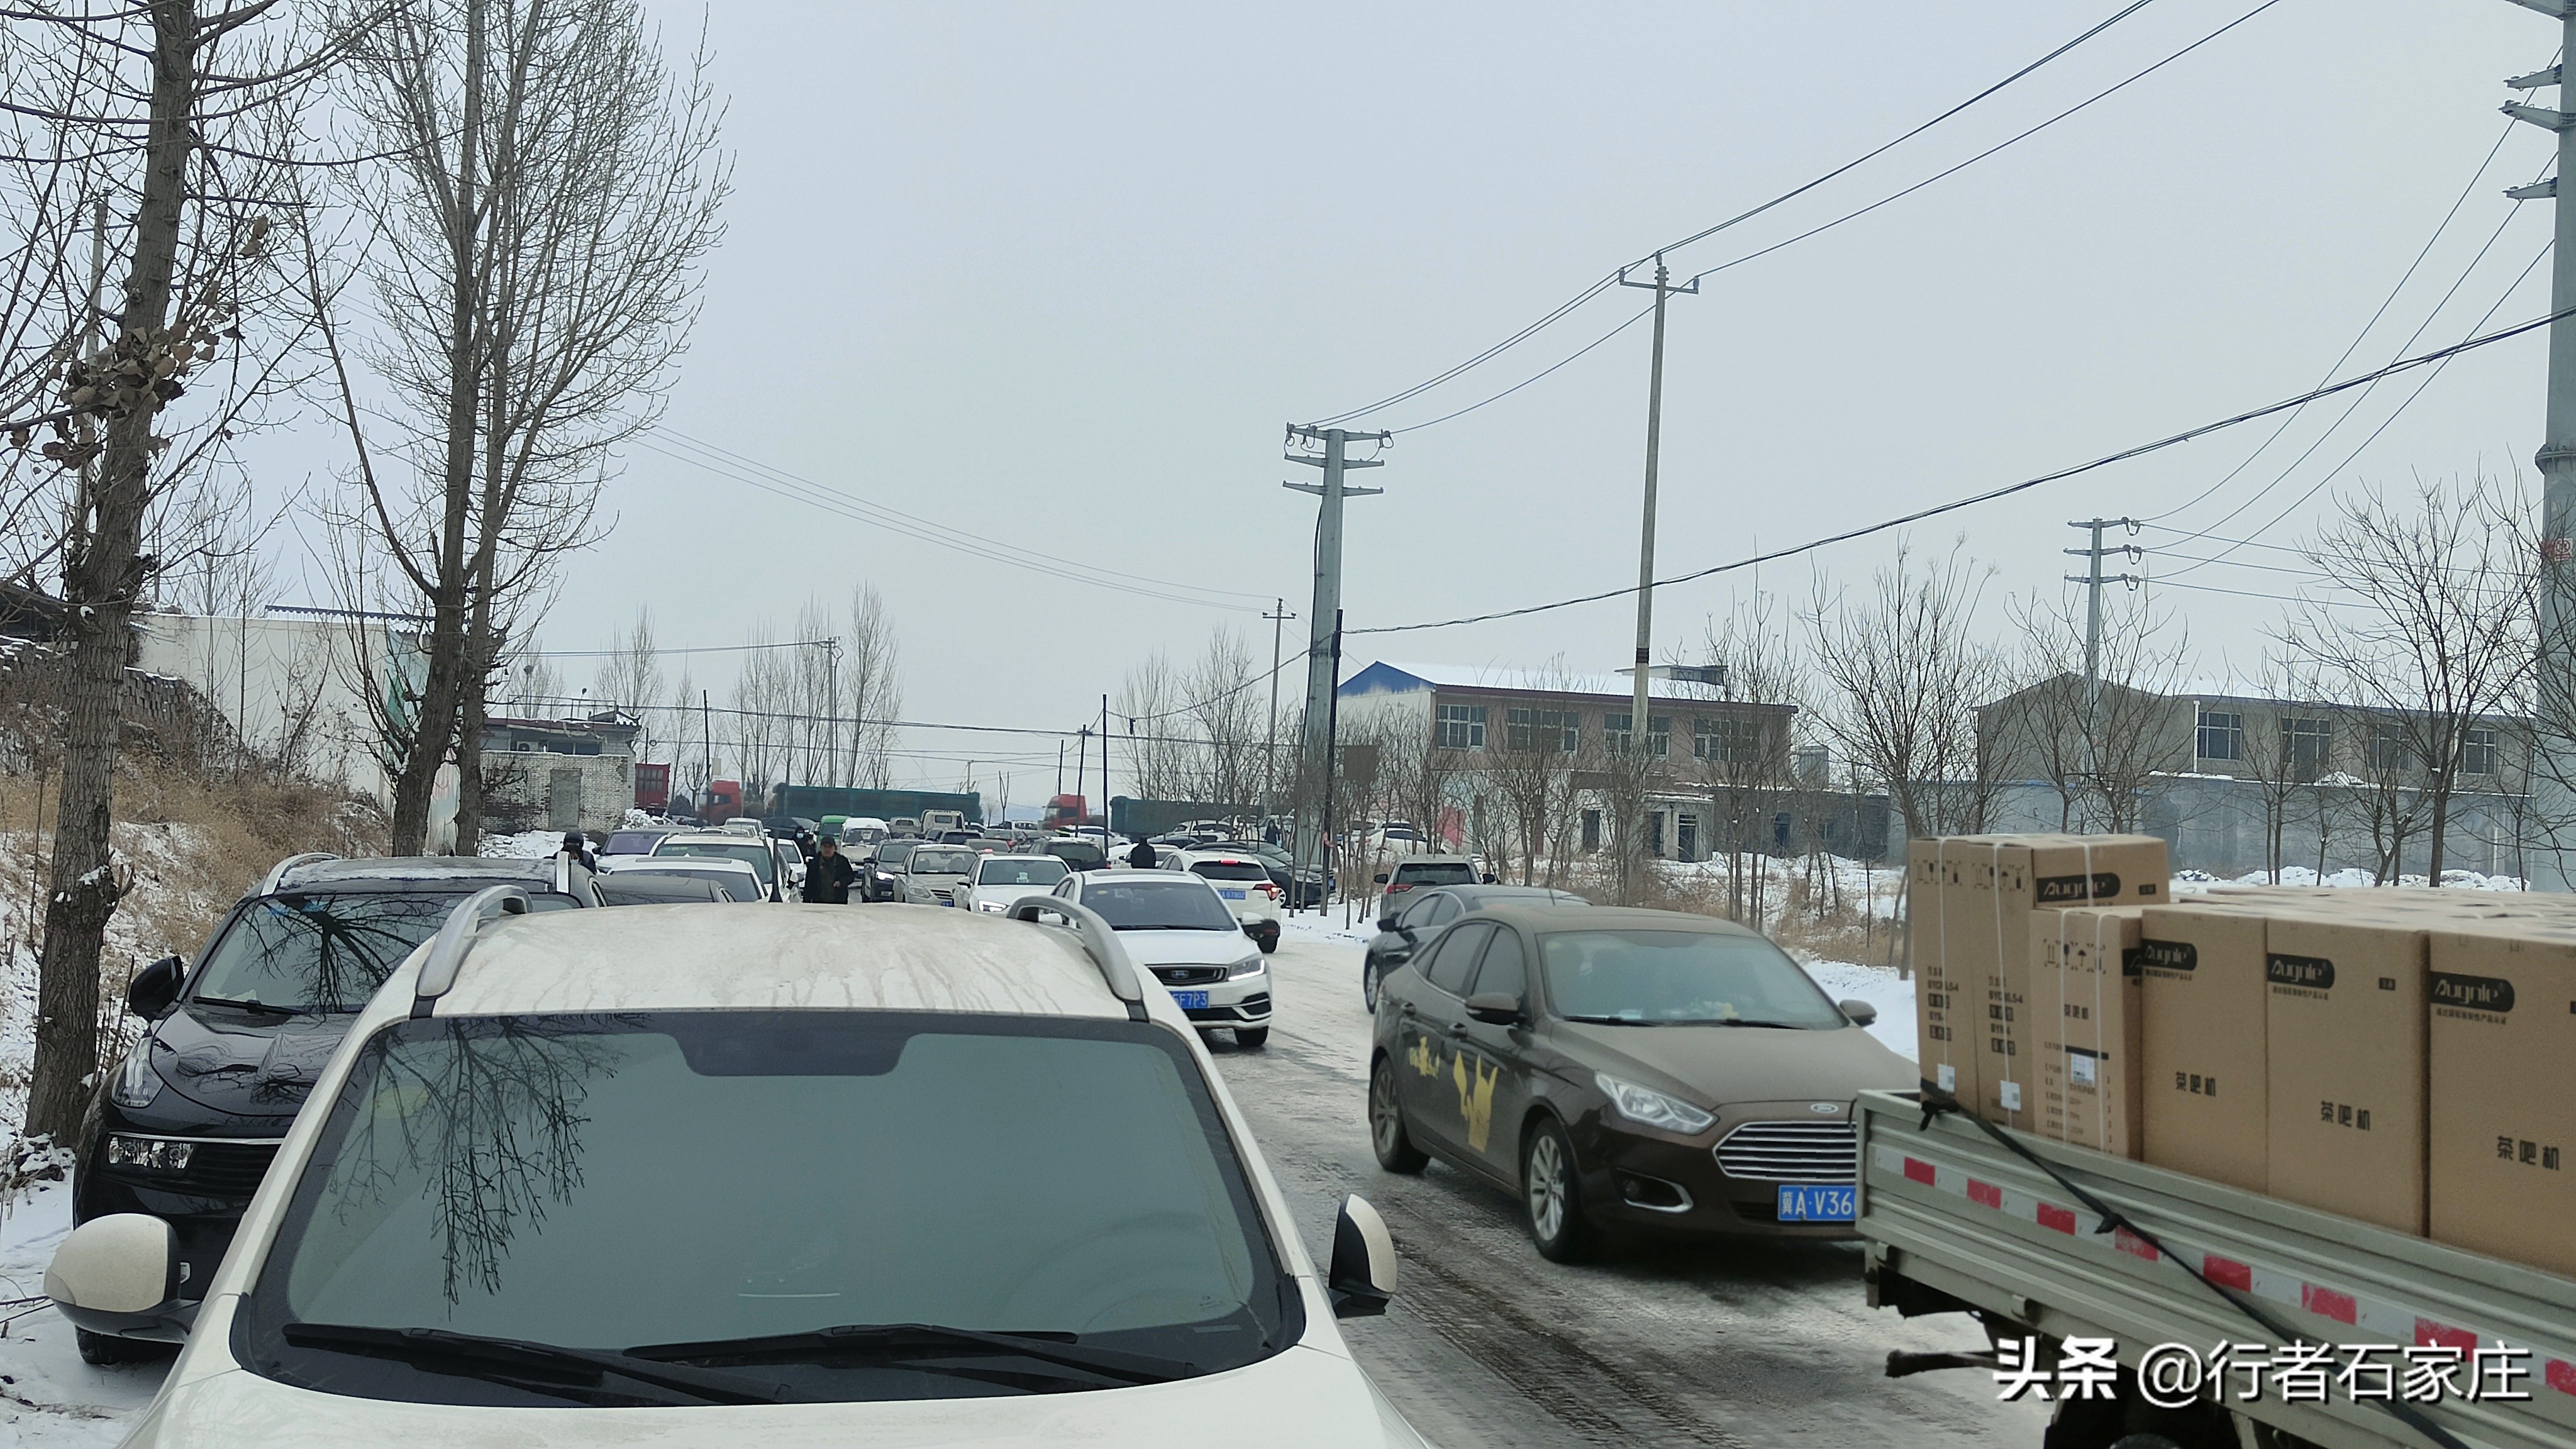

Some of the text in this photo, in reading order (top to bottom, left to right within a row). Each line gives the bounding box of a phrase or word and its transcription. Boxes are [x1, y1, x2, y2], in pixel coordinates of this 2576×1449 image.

[2175, 1070, 2217, 1097] 茶吧机
[2321, 1101, 2371, 1131] 茶吧机
[2496, 1136, 2560, 1172] 茶吧机
[1782, 1191, 1855, 1215] 冀A·V36
